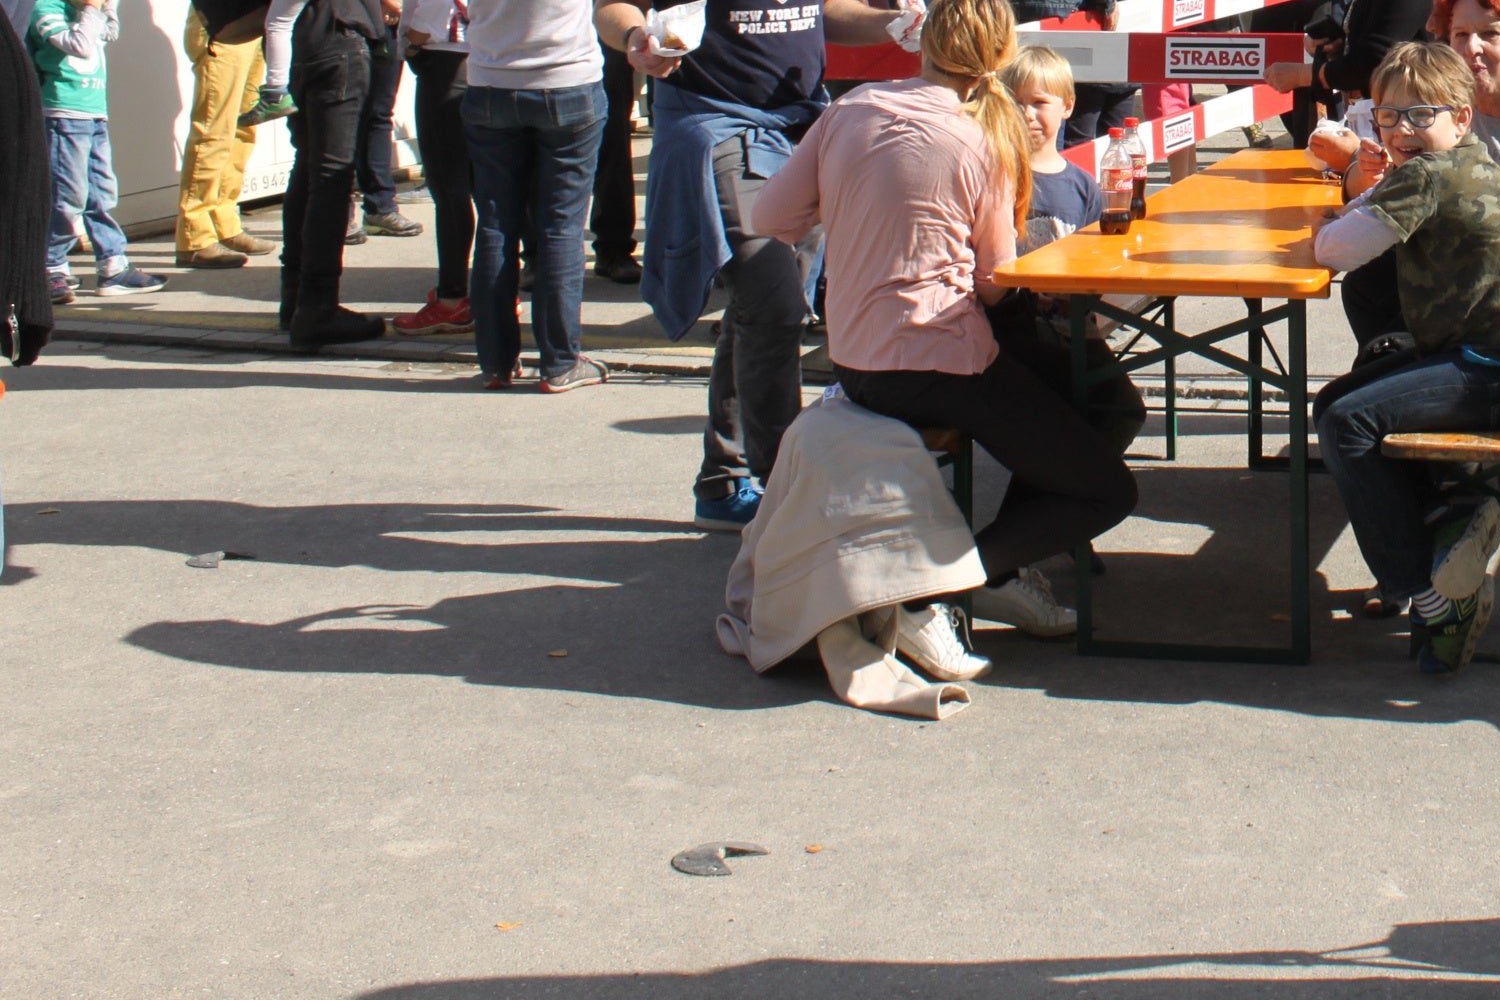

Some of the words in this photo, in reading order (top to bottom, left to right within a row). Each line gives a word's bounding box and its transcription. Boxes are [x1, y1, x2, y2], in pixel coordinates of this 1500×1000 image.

[1175, 0, 1204, 16] STRABAG
[730, 10, 763, 32] NEW
[767, 7, 799, 31] YORK
[802, 5, 820, 26] CITY
[738, 21, 788, 35] POLICE
[1170, 50, 1260, 66] STRABAG
[1165, 122, 1193, 142] STRABAG
